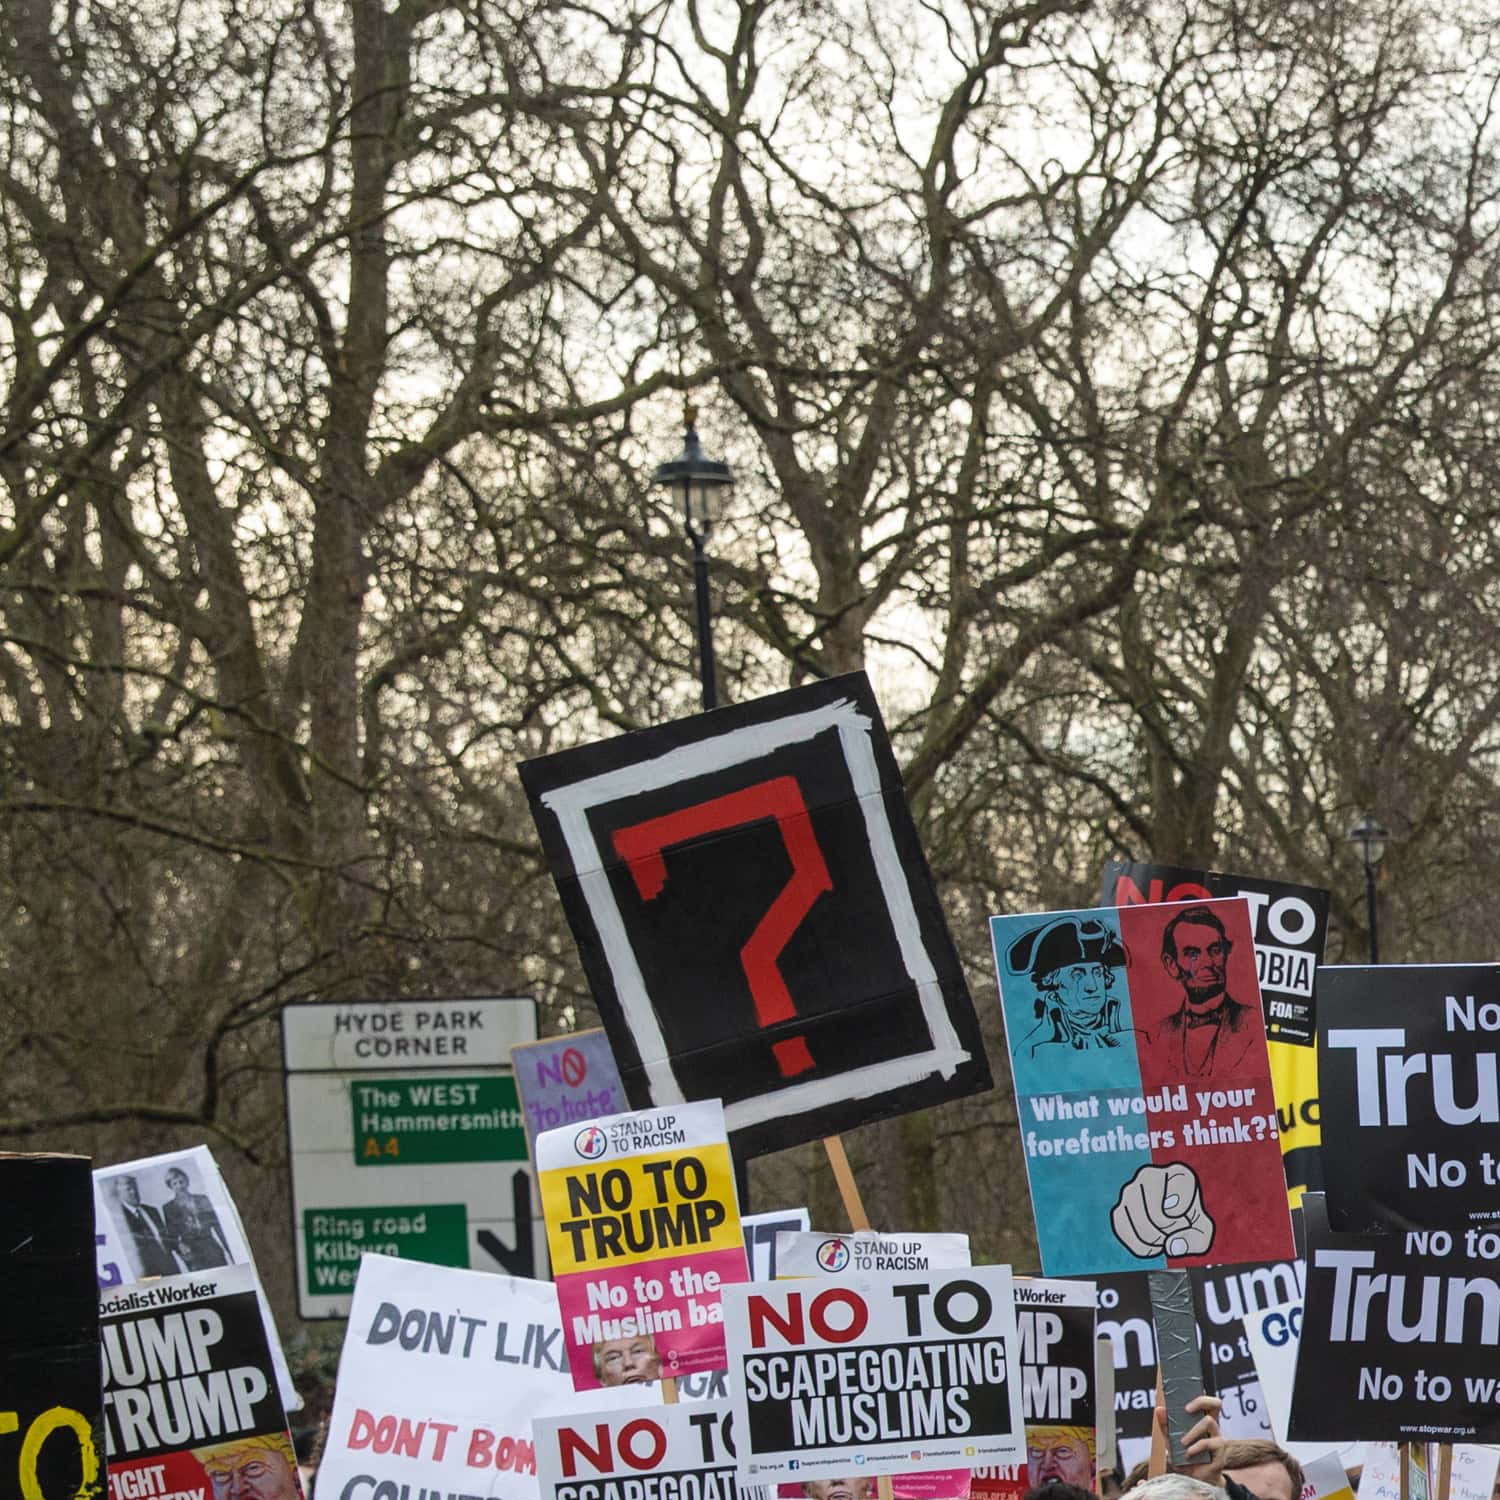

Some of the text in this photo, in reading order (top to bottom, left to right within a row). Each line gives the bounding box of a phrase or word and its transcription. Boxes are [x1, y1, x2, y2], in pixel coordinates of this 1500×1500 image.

[612, 775, 833, 1078] ?
[1237, 889, 1316, 945] TO
[335, 1011, 483, 1034] HYDE PARK
[355, 1036, 467, 1058] CORNER
[360, 1085, 480, 1108] The WEST
[1030, 1085, 1256, 1121] What would your
[361, 1110, 524, 1133] Hammersmith
[610, 1116, 676, 1138] STAND UP
[1026, 1126, 1175, 1157] forefathers
[1182, 1115, 1278, 1146] think?!
[611, 1131, 686, 1153] TO RACISM
[566, 1156, 707, 1218] NO TO
[1407, 1153, 1466, 1189] No
[312, 1214, 426, 1242] Ring road
[560, 1199, 726, 1263] TRUMP
[1405, 1231, 1453, 1257] No
[854, 1242, 922, 1256] STAND UP
[854, 1257, 929, 1271] TO RACISM
[586, 1267, 720, 1311] No to the
[366, 1302, 487, 1358] DON'T
[572, 1306, 682, 1346] Muslim
[747, 1279, 993, 1348] NO TO
[746, 1341, 1006, 1402] SCAPEGOATING
[1358, 1367, 1453, 1402] No to
[791, 1386, 972, 1447] MUSLIMS
[1400, 1422, 1476, 1436] www.stopwar.org.uk
[347, 1409, 458, 1462] DON'T
[557, 1418, 667, 1478] NO
